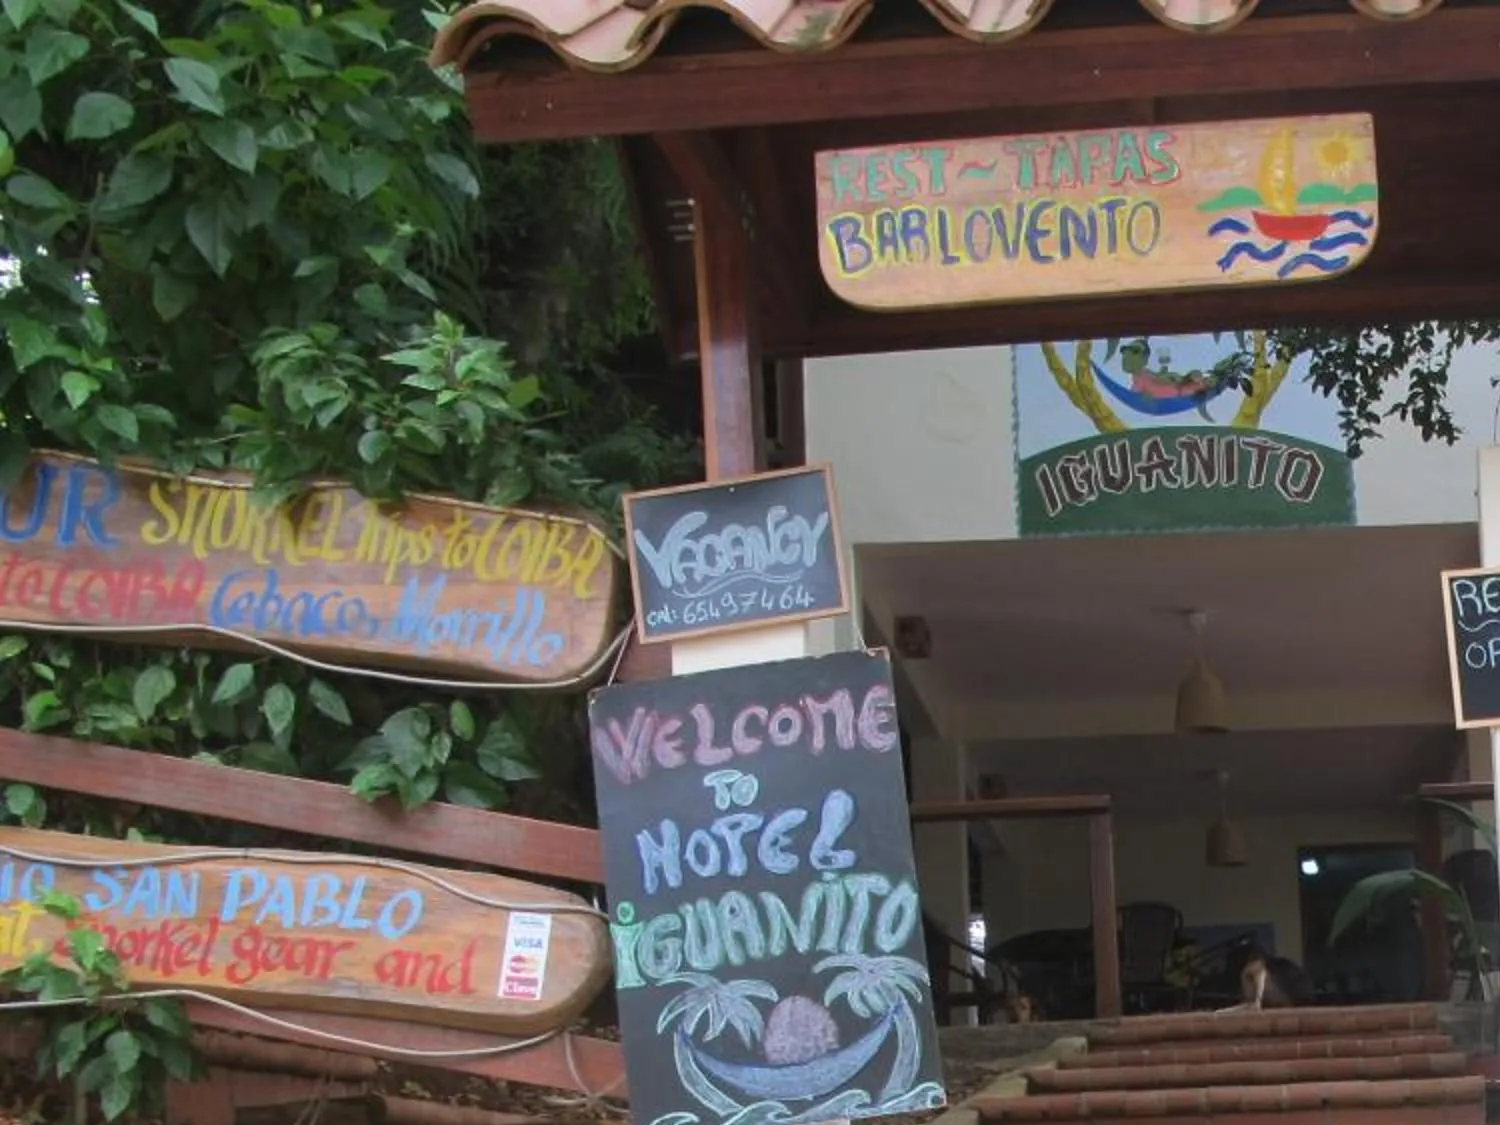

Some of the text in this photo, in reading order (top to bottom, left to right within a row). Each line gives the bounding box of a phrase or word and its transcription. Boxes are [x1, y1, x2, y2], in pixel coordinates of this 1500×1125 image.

[829, 132, 1181, 204] REST TAPAS
[826, 197, 1162, 278] BARLOVENTO
[1034, 433, 1324, 517] IGUANITO
[634, 505, 829, 590] VACANCY
[595, 684, 898, 785] WELCOME
[703, 769, 759, 811] TO
[635, 788, 857, 895] HOTEL
[83, 865, 200, 918] SAN
[221, 866, 426, 941] PABLO
[225, 925, 356, 986] gear
[374, 930, 479, 995] and
